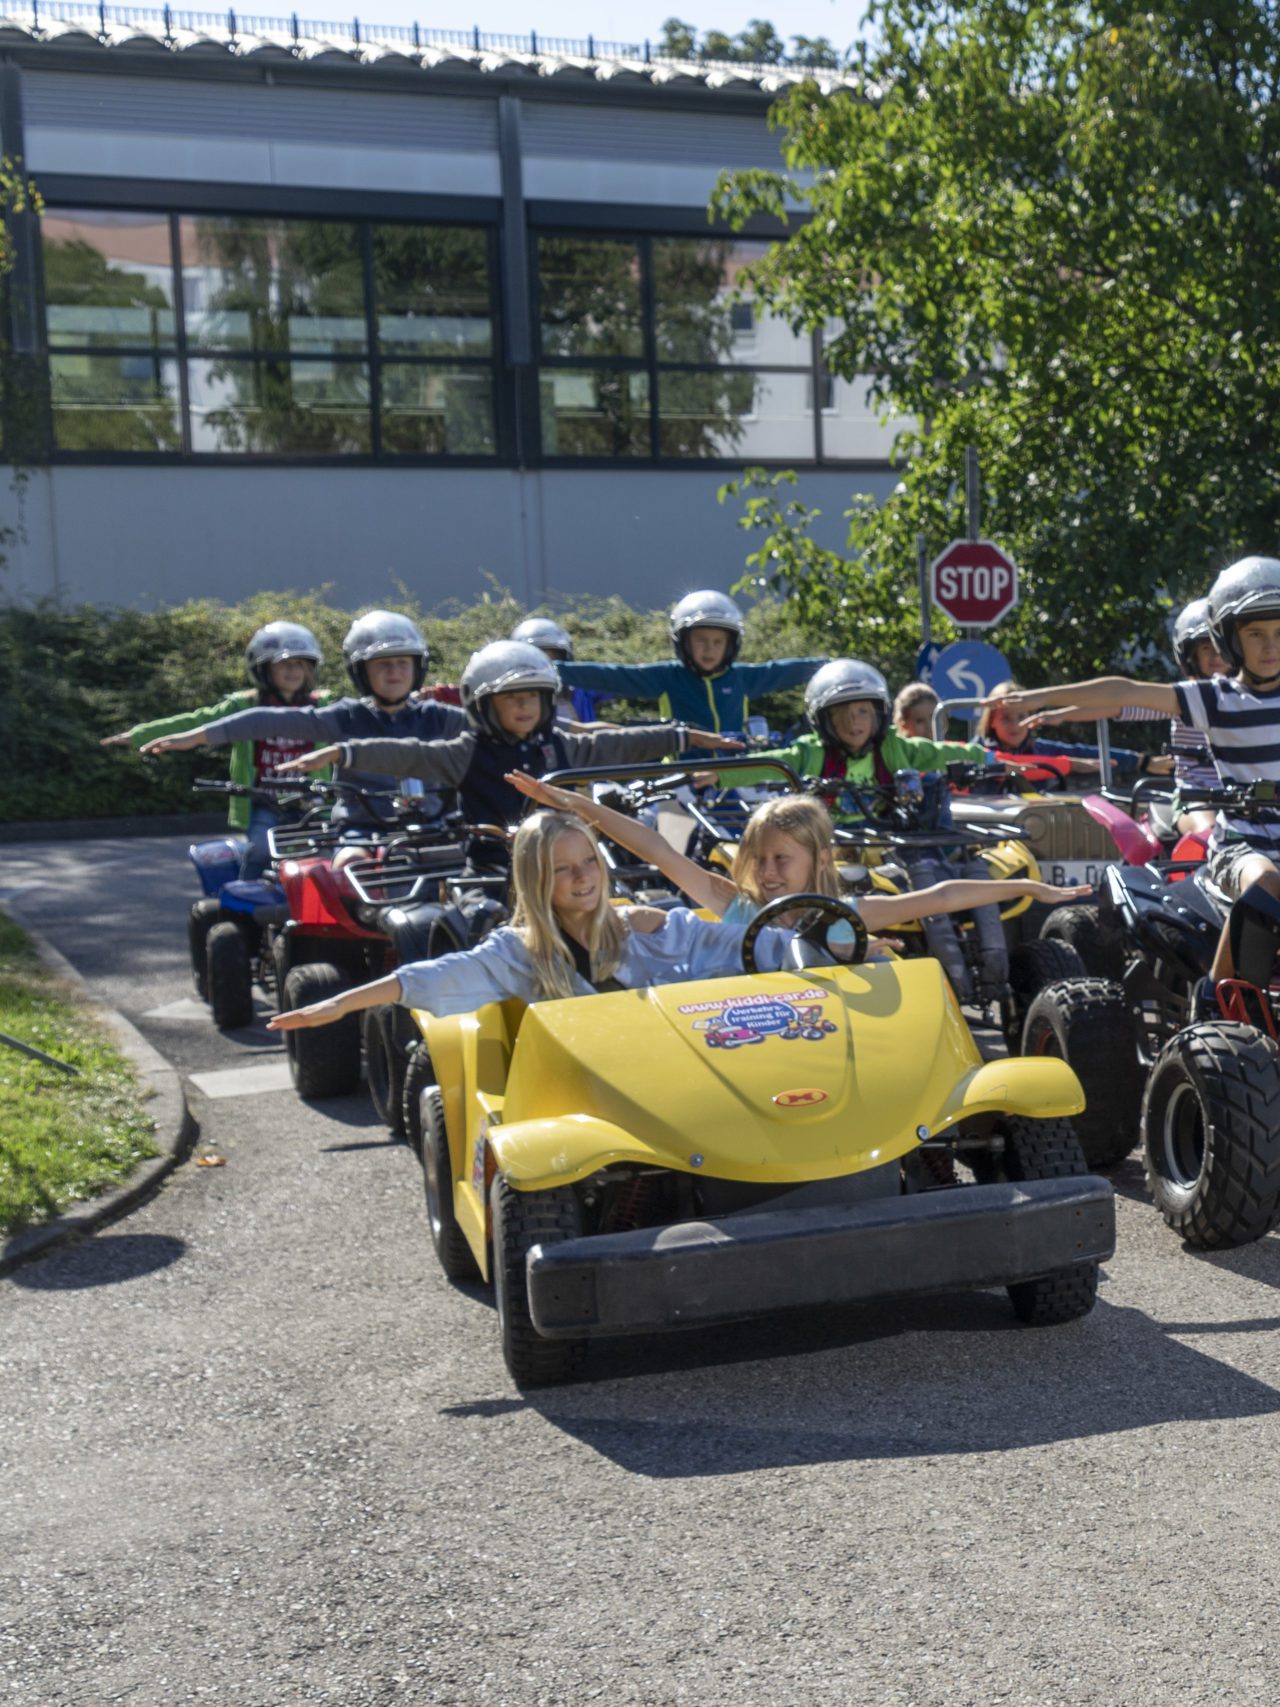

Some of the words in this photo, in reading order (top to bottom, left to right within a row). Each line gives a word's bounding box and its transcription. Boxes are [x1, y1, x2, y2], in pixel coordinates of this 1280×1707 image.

[940, 566, 1010, 601] STOP
[679, 989, 827, 1014] www.kiddi-car.de
[731, 1013, 775, 1022] training
[746, 1019, 781, 1028] Kinder
